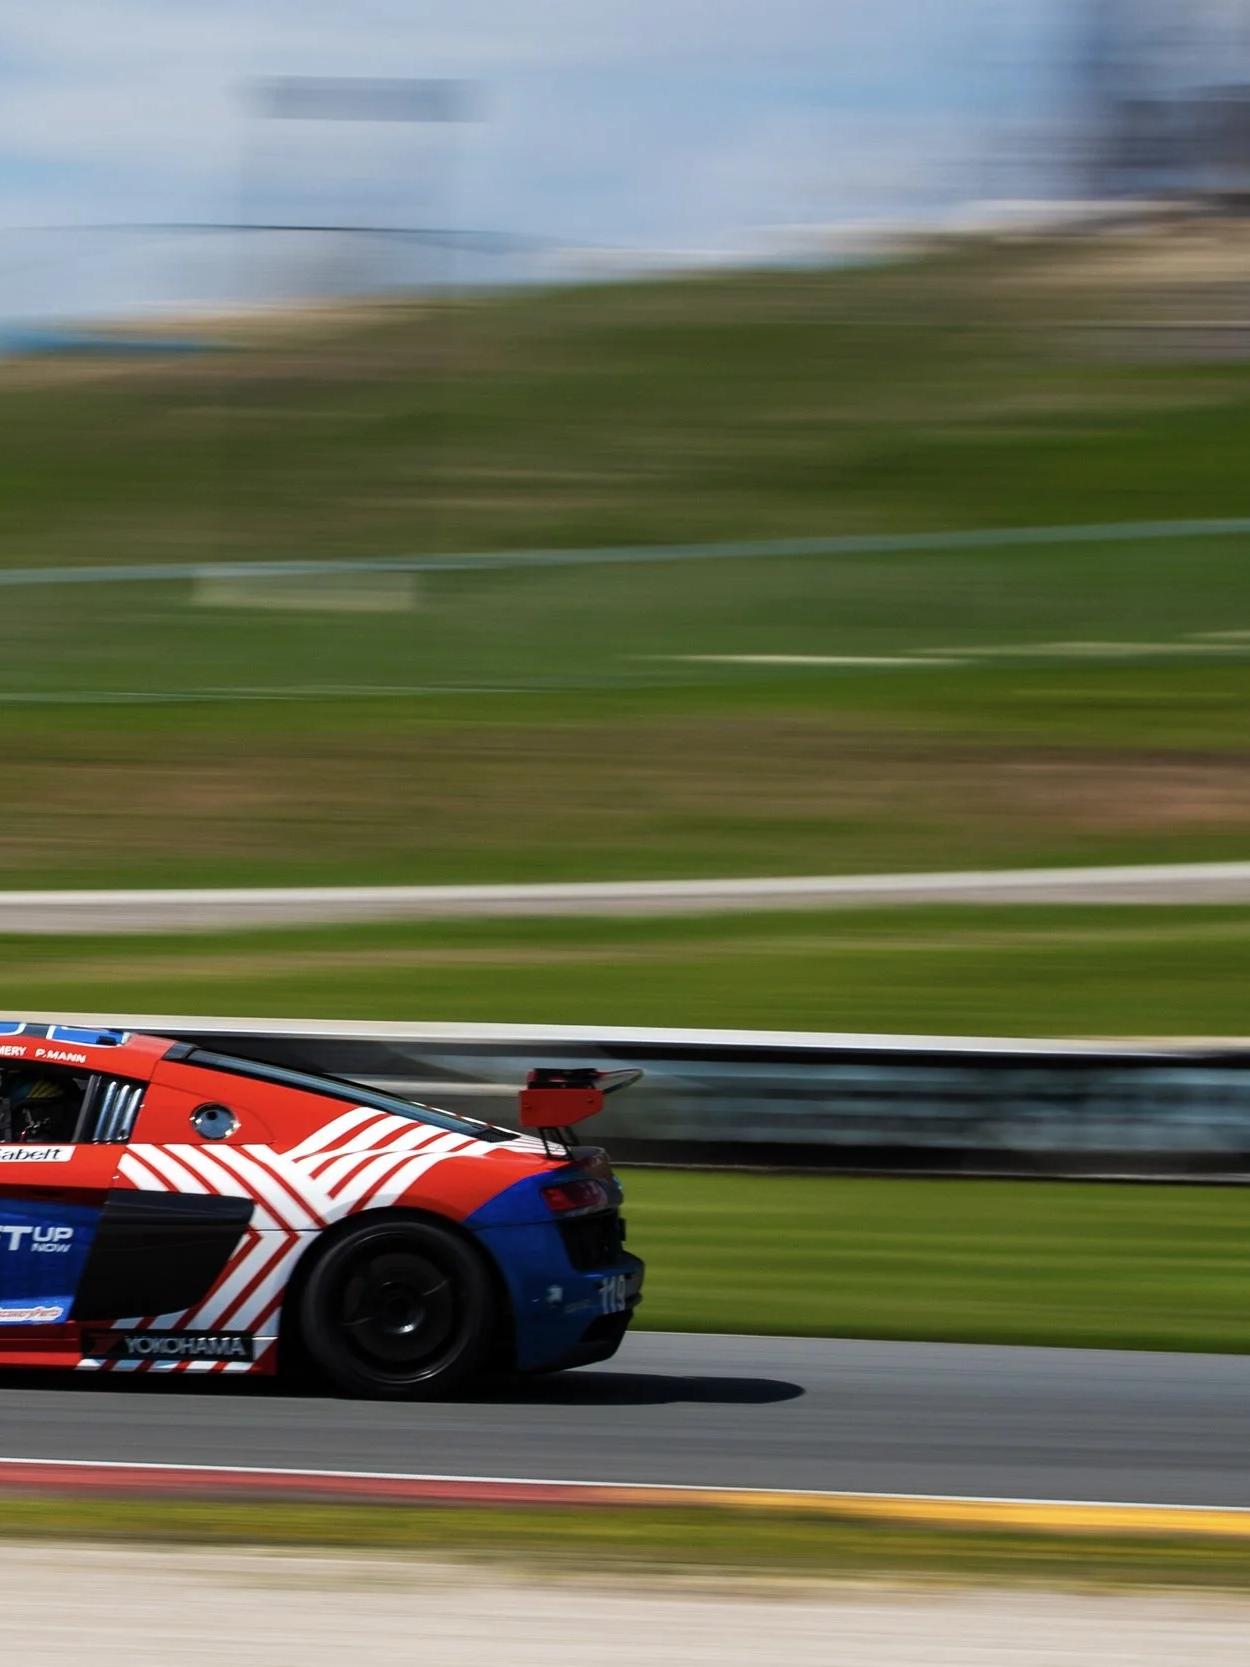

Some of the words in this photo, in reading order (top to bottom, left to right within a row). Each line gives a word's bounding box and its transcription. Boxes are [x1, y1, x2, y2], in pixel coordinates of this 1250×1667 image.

[32, 1226, 74, 1242] UP
[31, 1243, 72, 1253] NOW
[124, 1335, 246, 1356] YOKOHAMA
